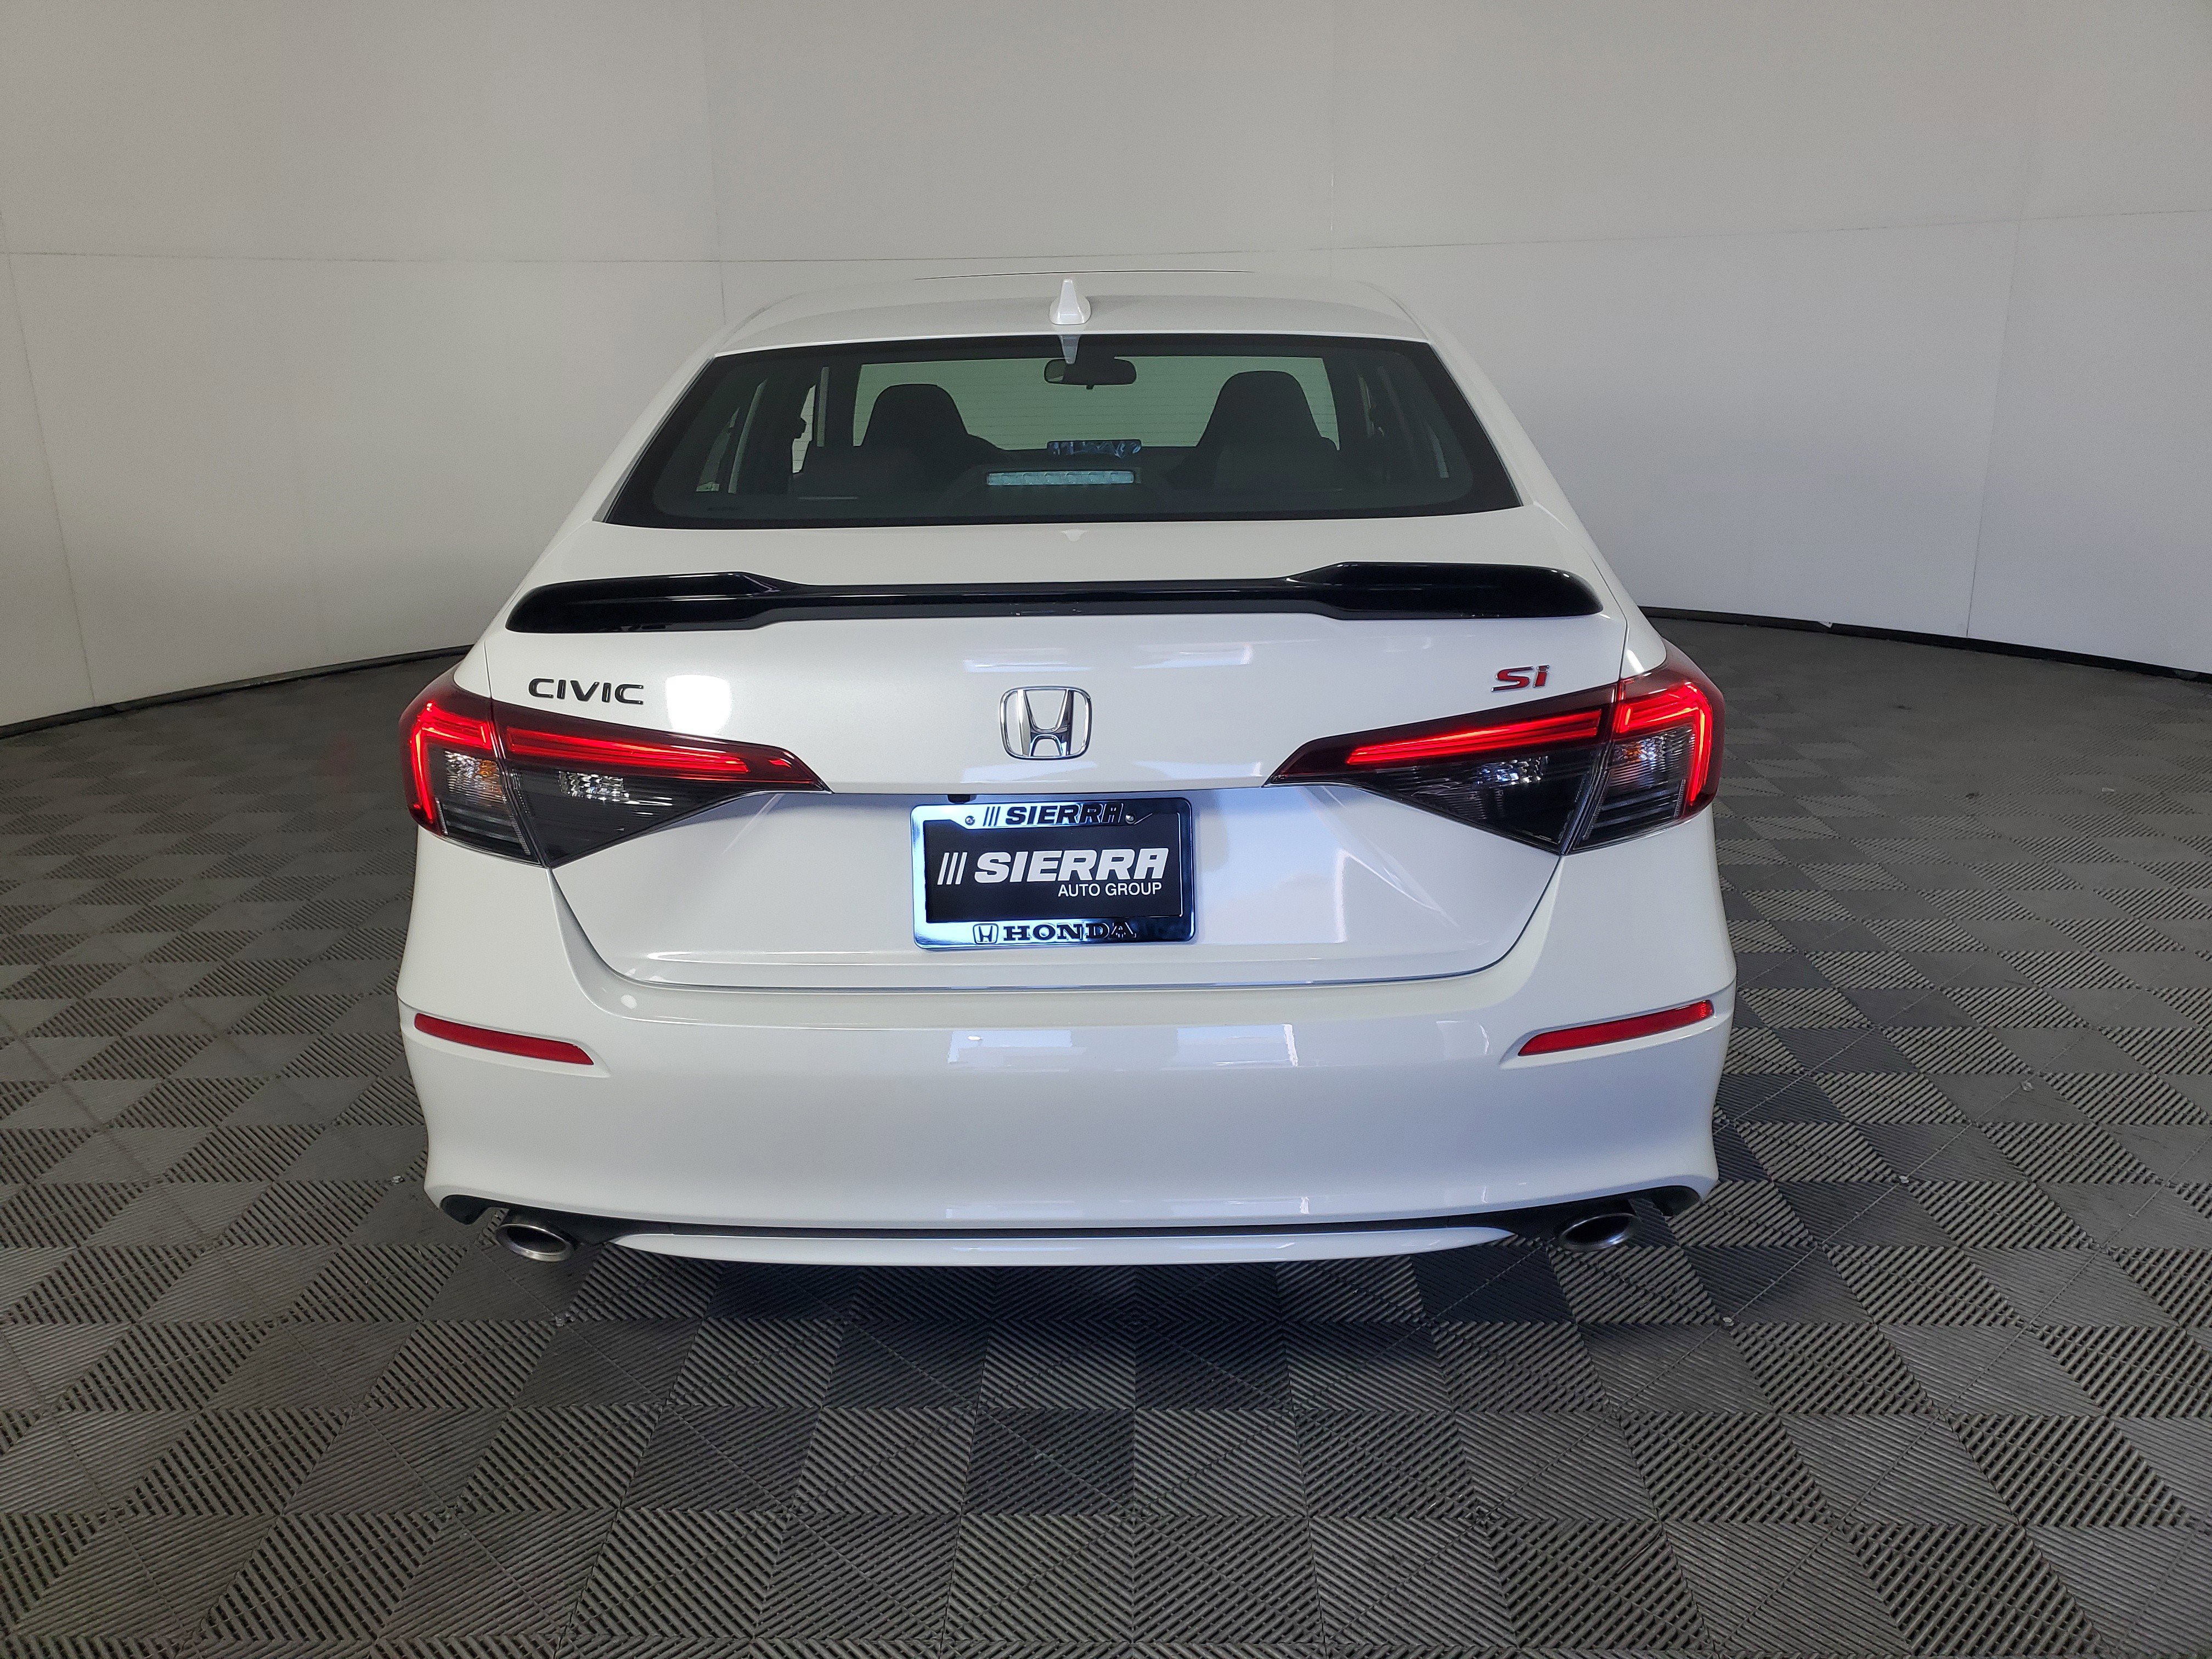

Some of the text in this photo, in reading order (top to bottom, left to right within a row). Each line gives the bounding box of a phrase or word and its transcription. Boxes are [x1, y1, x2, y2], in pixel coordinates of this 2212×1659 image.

[1491, 665, 1550, 692] Si
[528, 678, 644, 705] CIVIC
[1006, 804, 1124, 825] SIERRA
[974, 848, 1169, 883] SIERRA
[1058, 882, 1162, 897] AUTO GROUP
[1003, 922, 1137, 942] HONDA
